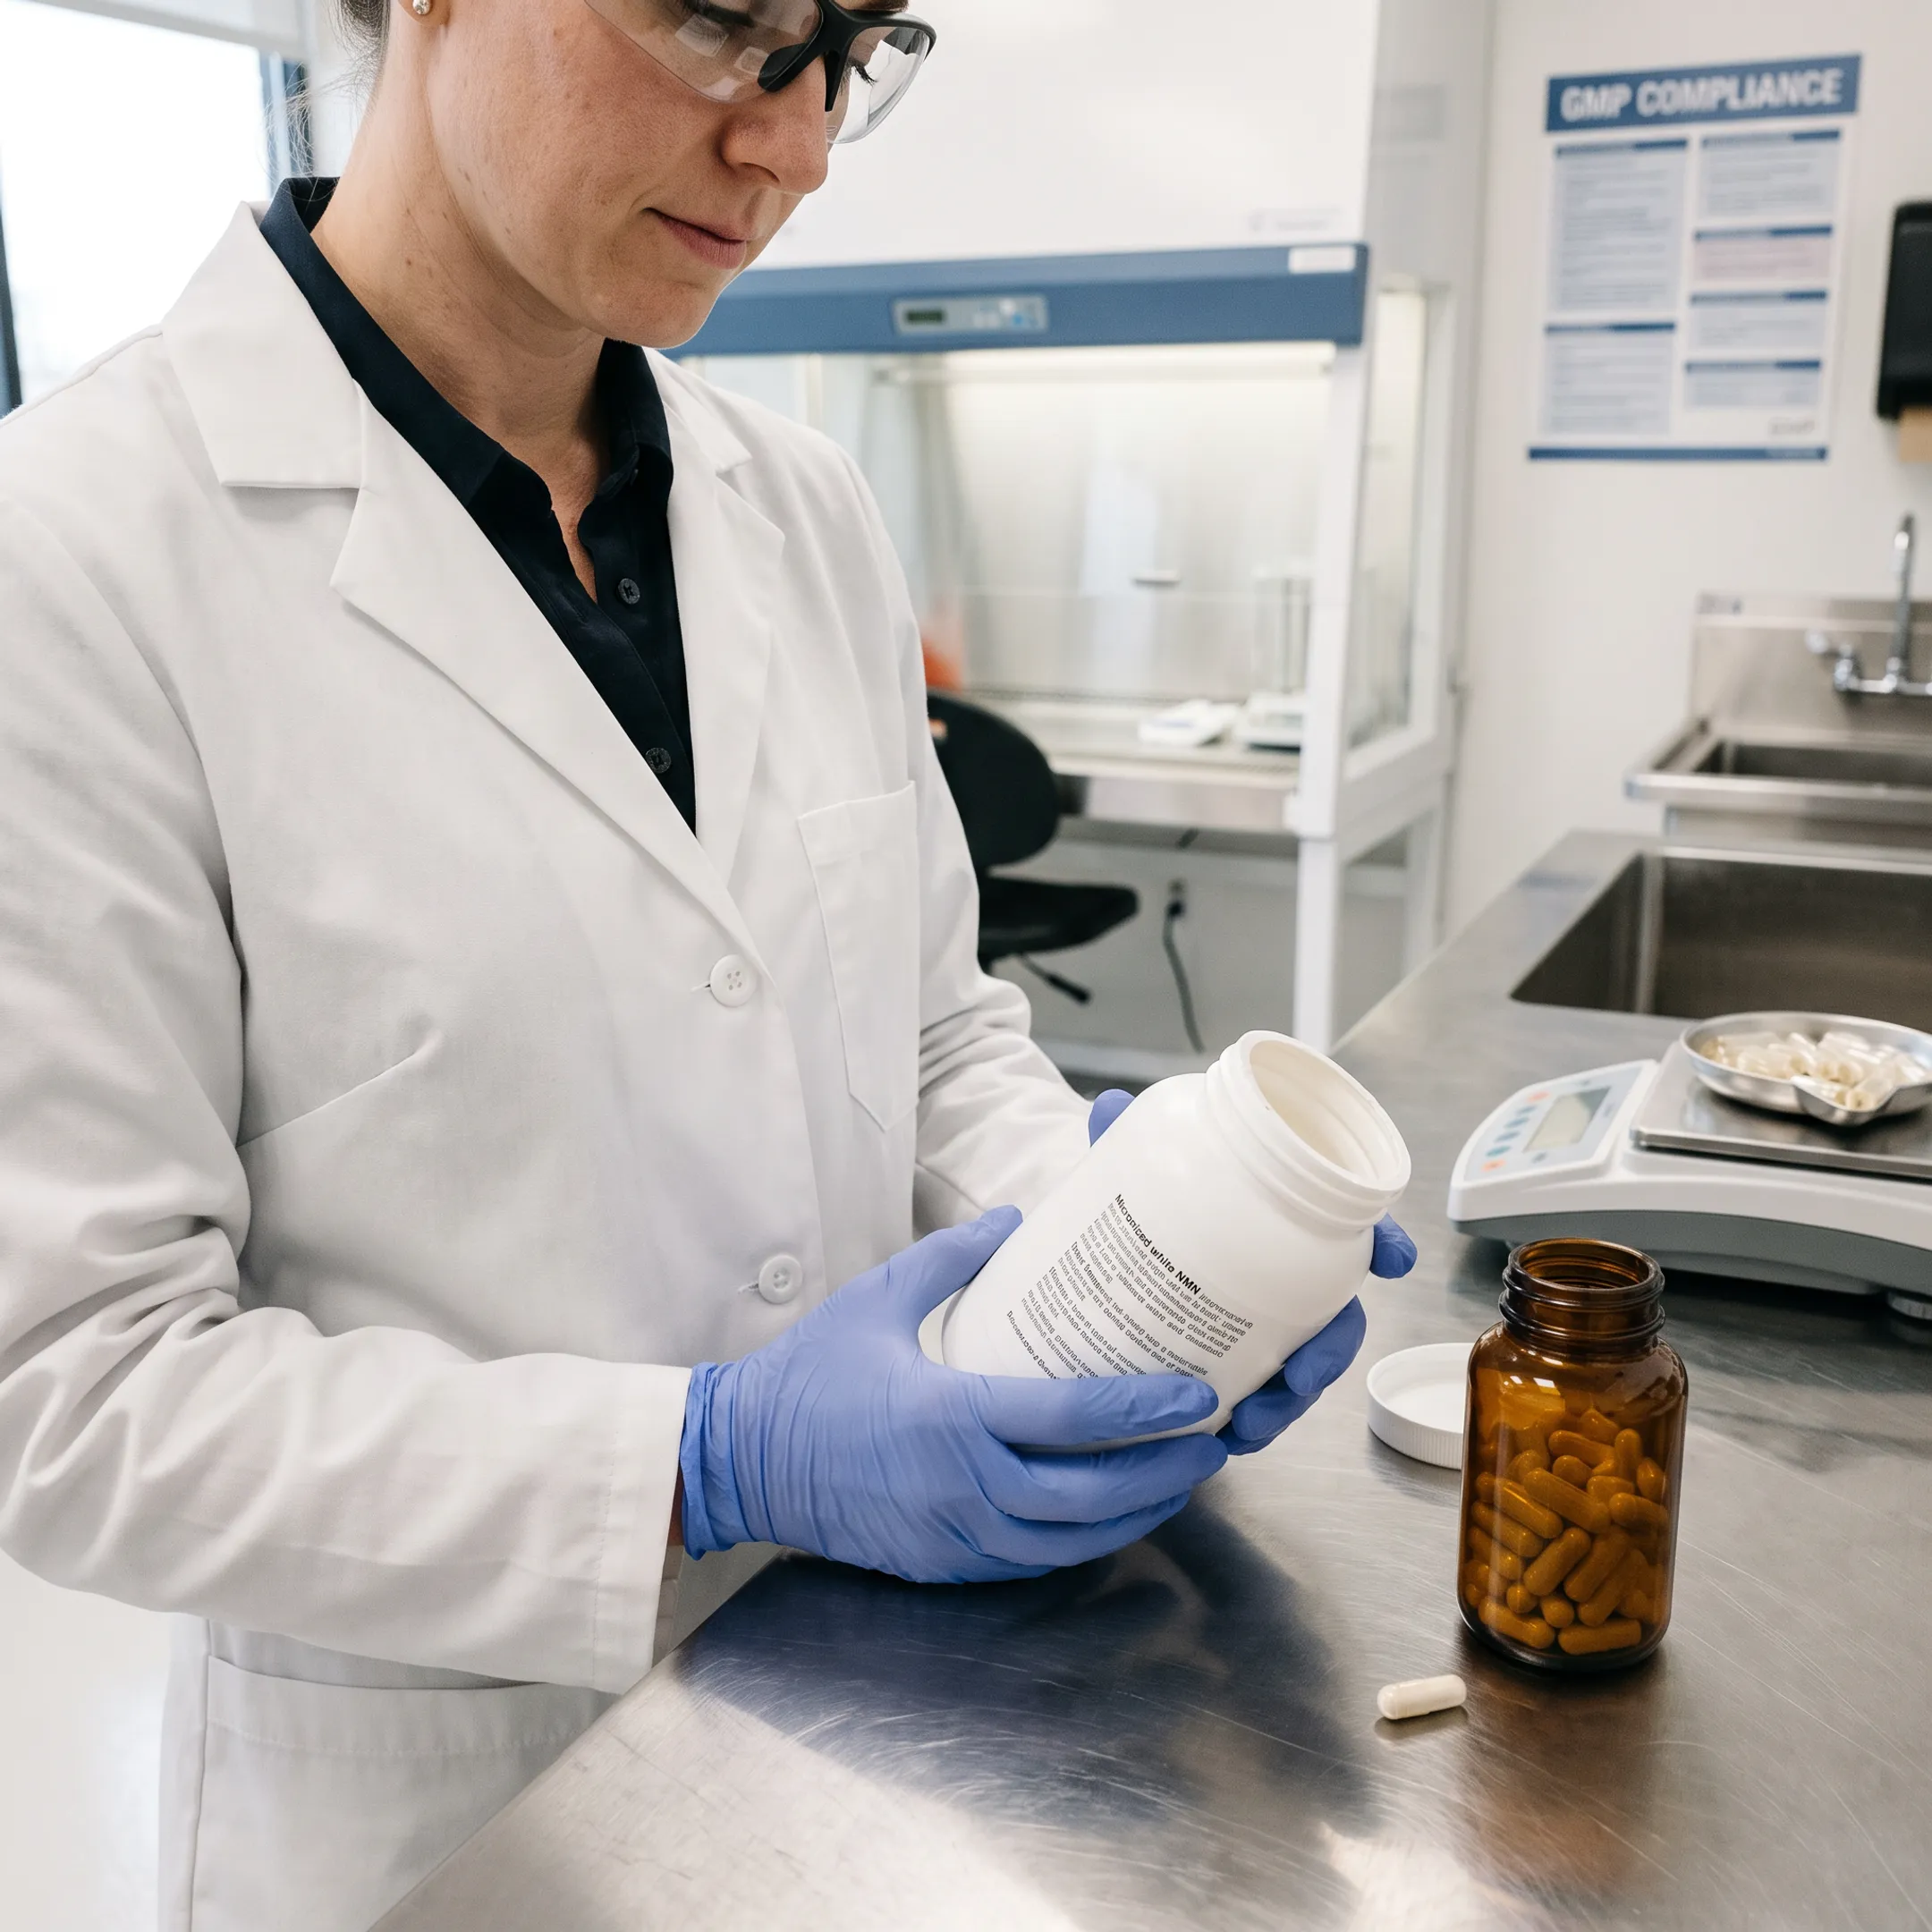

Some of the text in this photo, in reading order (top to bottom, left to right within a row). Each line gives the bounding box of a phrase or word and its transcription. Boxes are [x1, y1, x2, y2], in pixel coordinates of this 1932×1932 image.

[1560, 68, 1843, 123] GMP COMPLIANCE
[1174, 1270, 1201, 1295] NMN
